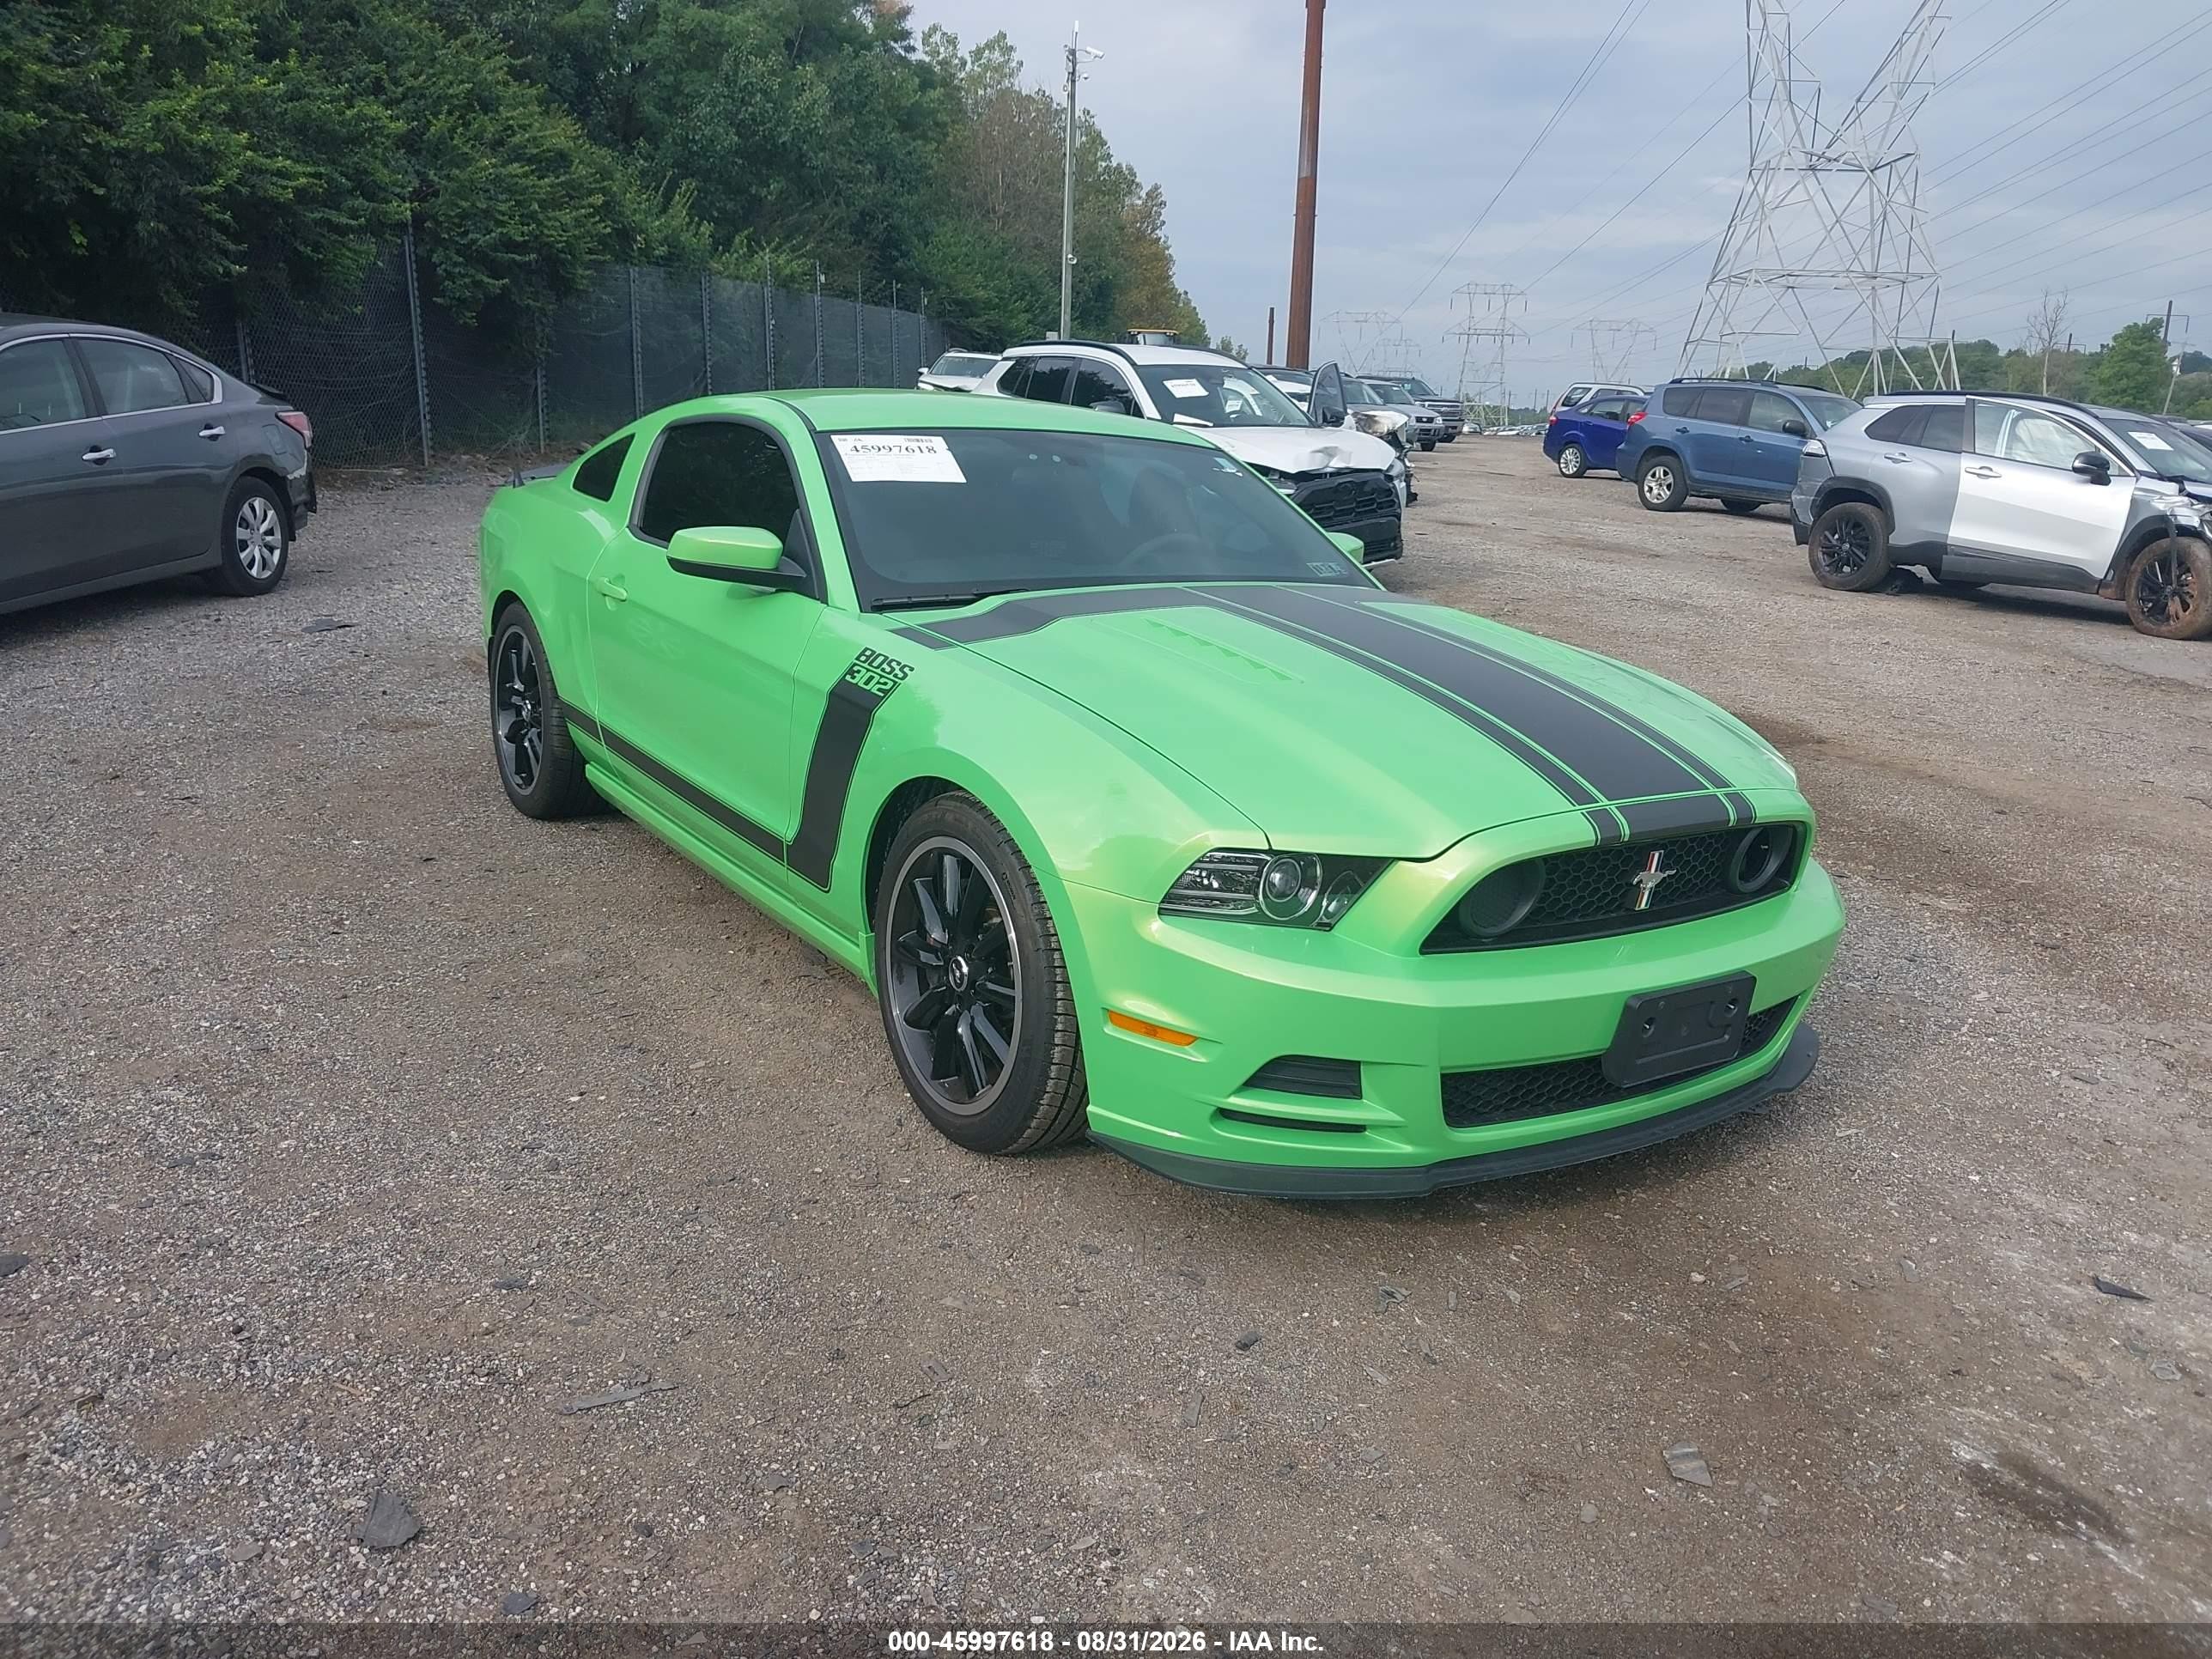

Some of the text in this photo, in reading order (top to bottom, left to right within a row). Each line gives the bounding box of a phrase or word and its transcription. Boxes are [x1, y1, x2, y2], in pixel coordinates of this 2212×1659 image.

[850, 445, 937, 454] 45997618
[854, 646, 915, 681] BOSS
[844, 665, 895, 697] 302
